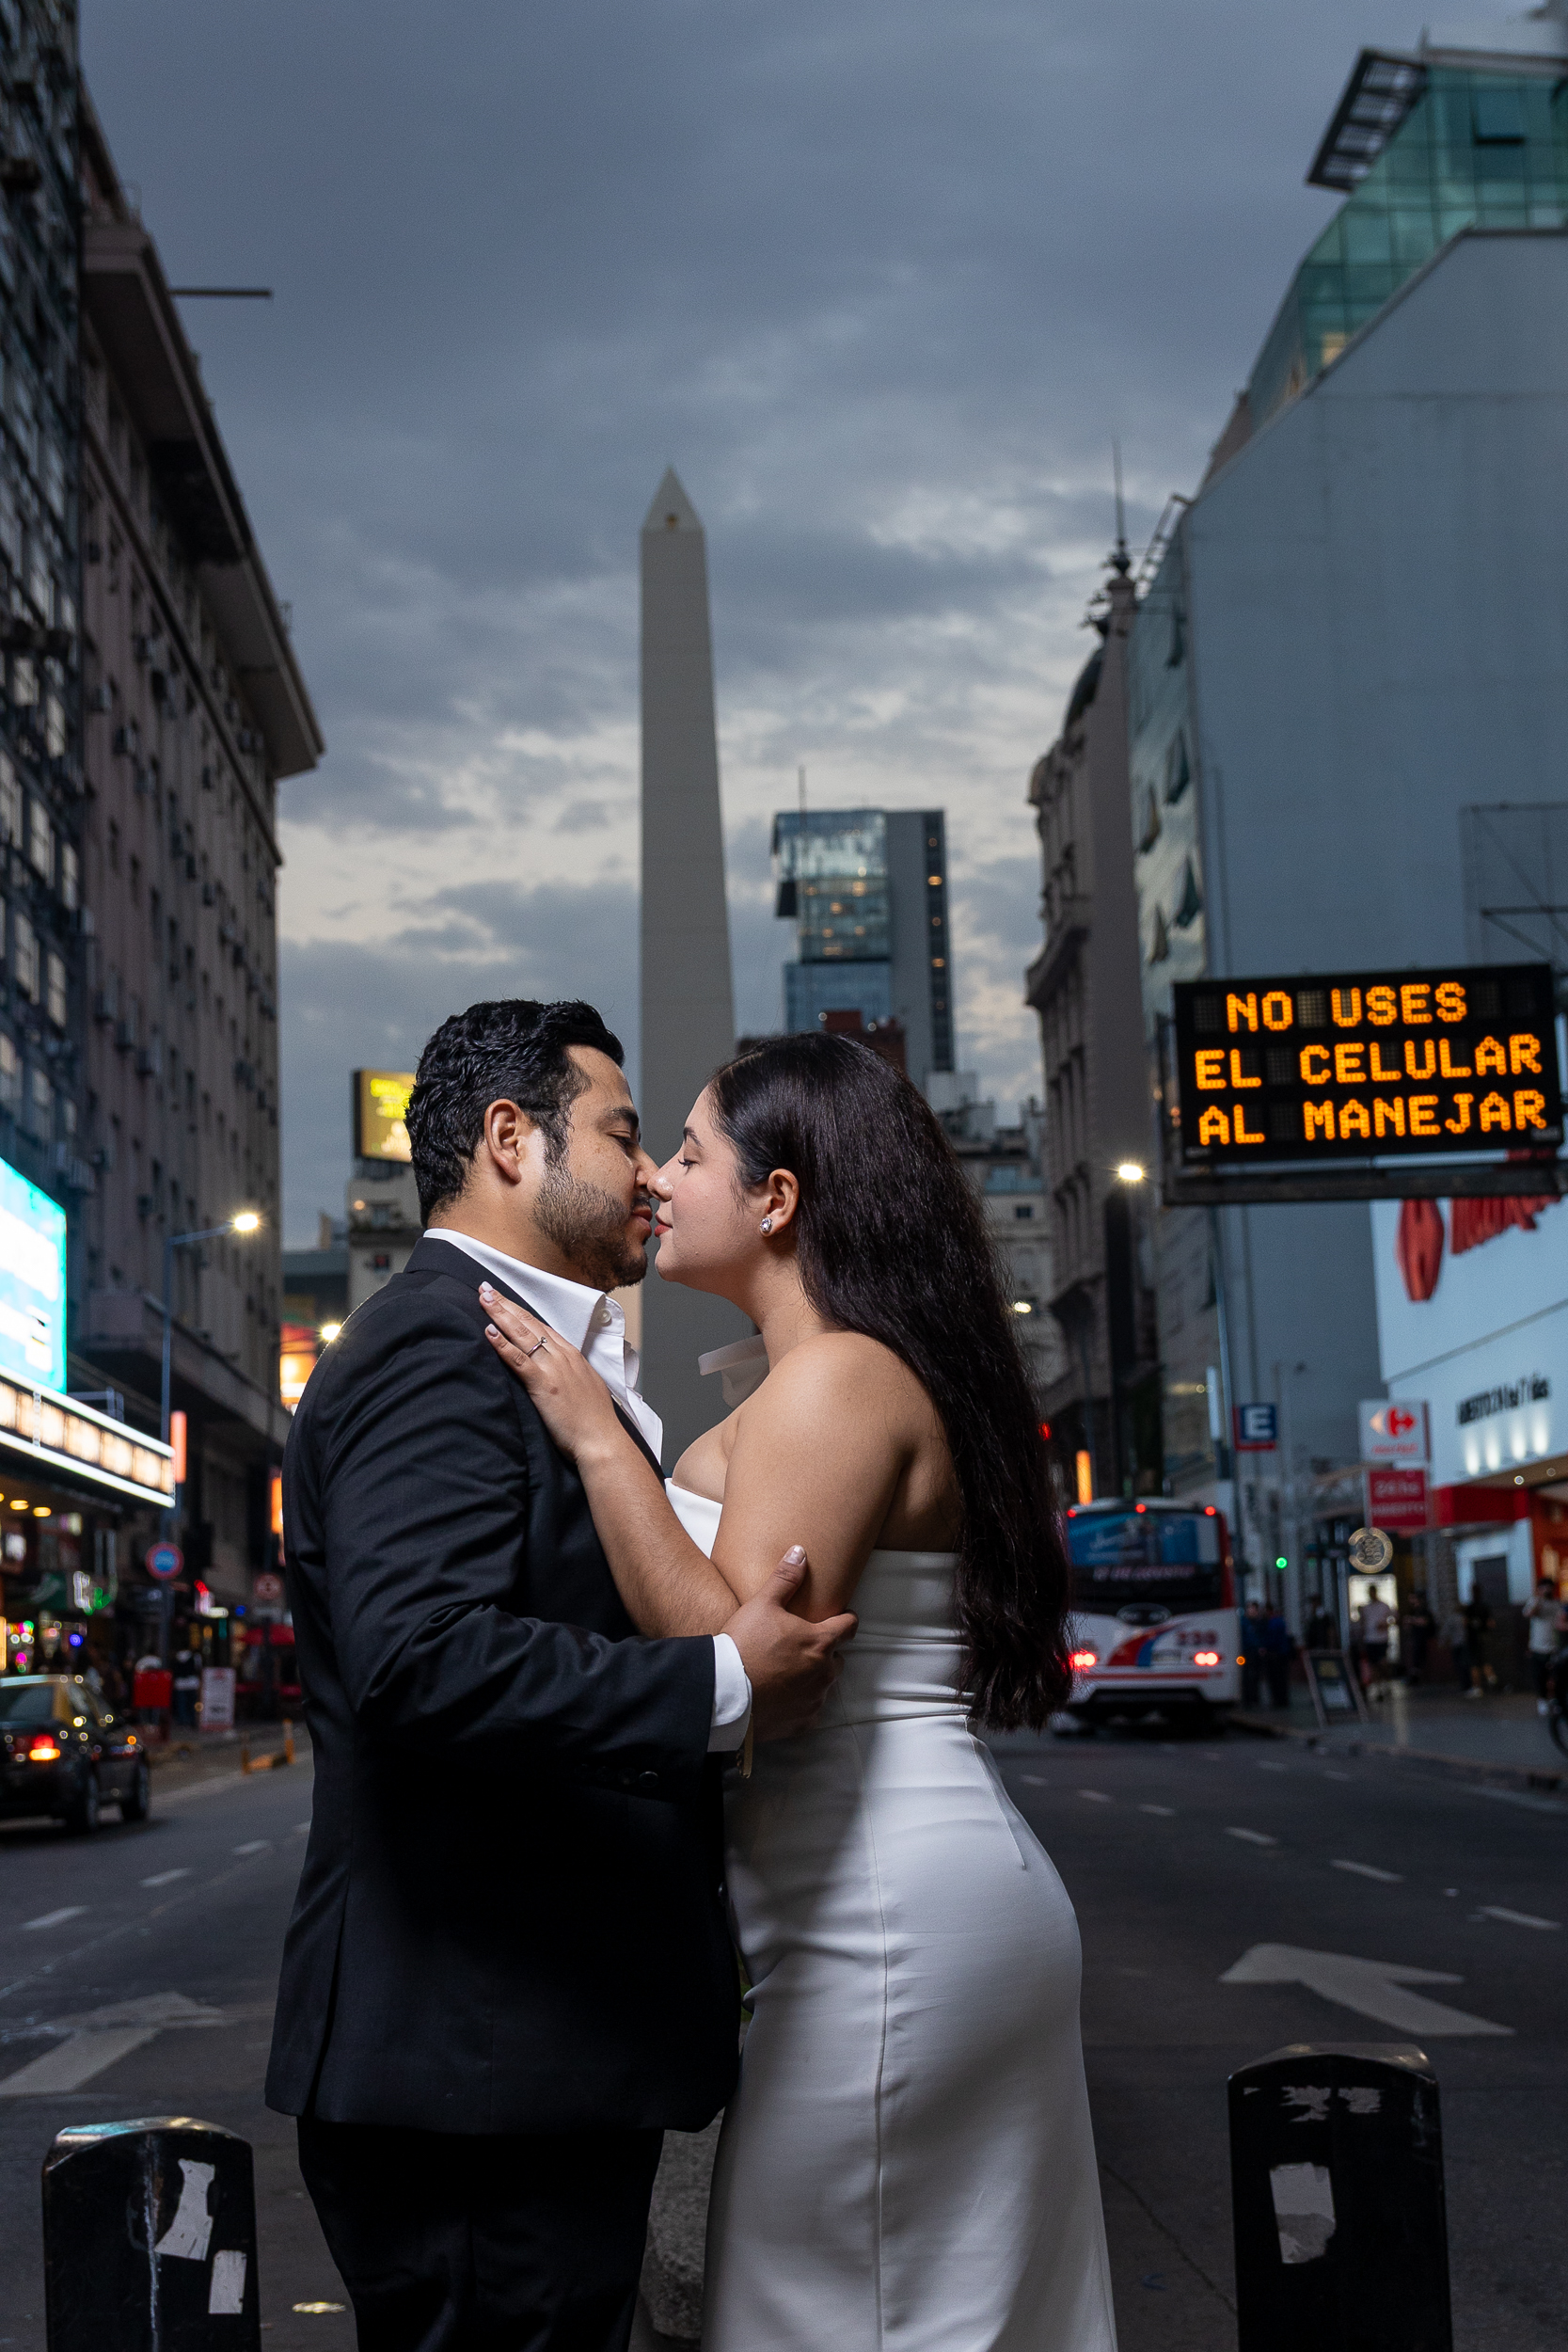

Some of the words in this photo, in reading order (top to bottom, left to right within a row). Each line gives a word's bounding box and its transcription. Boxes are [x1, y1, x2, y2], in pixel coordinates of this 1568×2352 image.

[1226, 991, 1293, 1032] NO
[1331, 982, 1467, 1027] USES
[1195, 1048, 1262, 1090] EL
[1299, 1033, 1543, 1085] CELULAR
[1198, 1104, 1265, 1146] AL
[1303, 1089, 1546, 1141] MANEJAR
[1244, 1407, 1272, 1438] E
